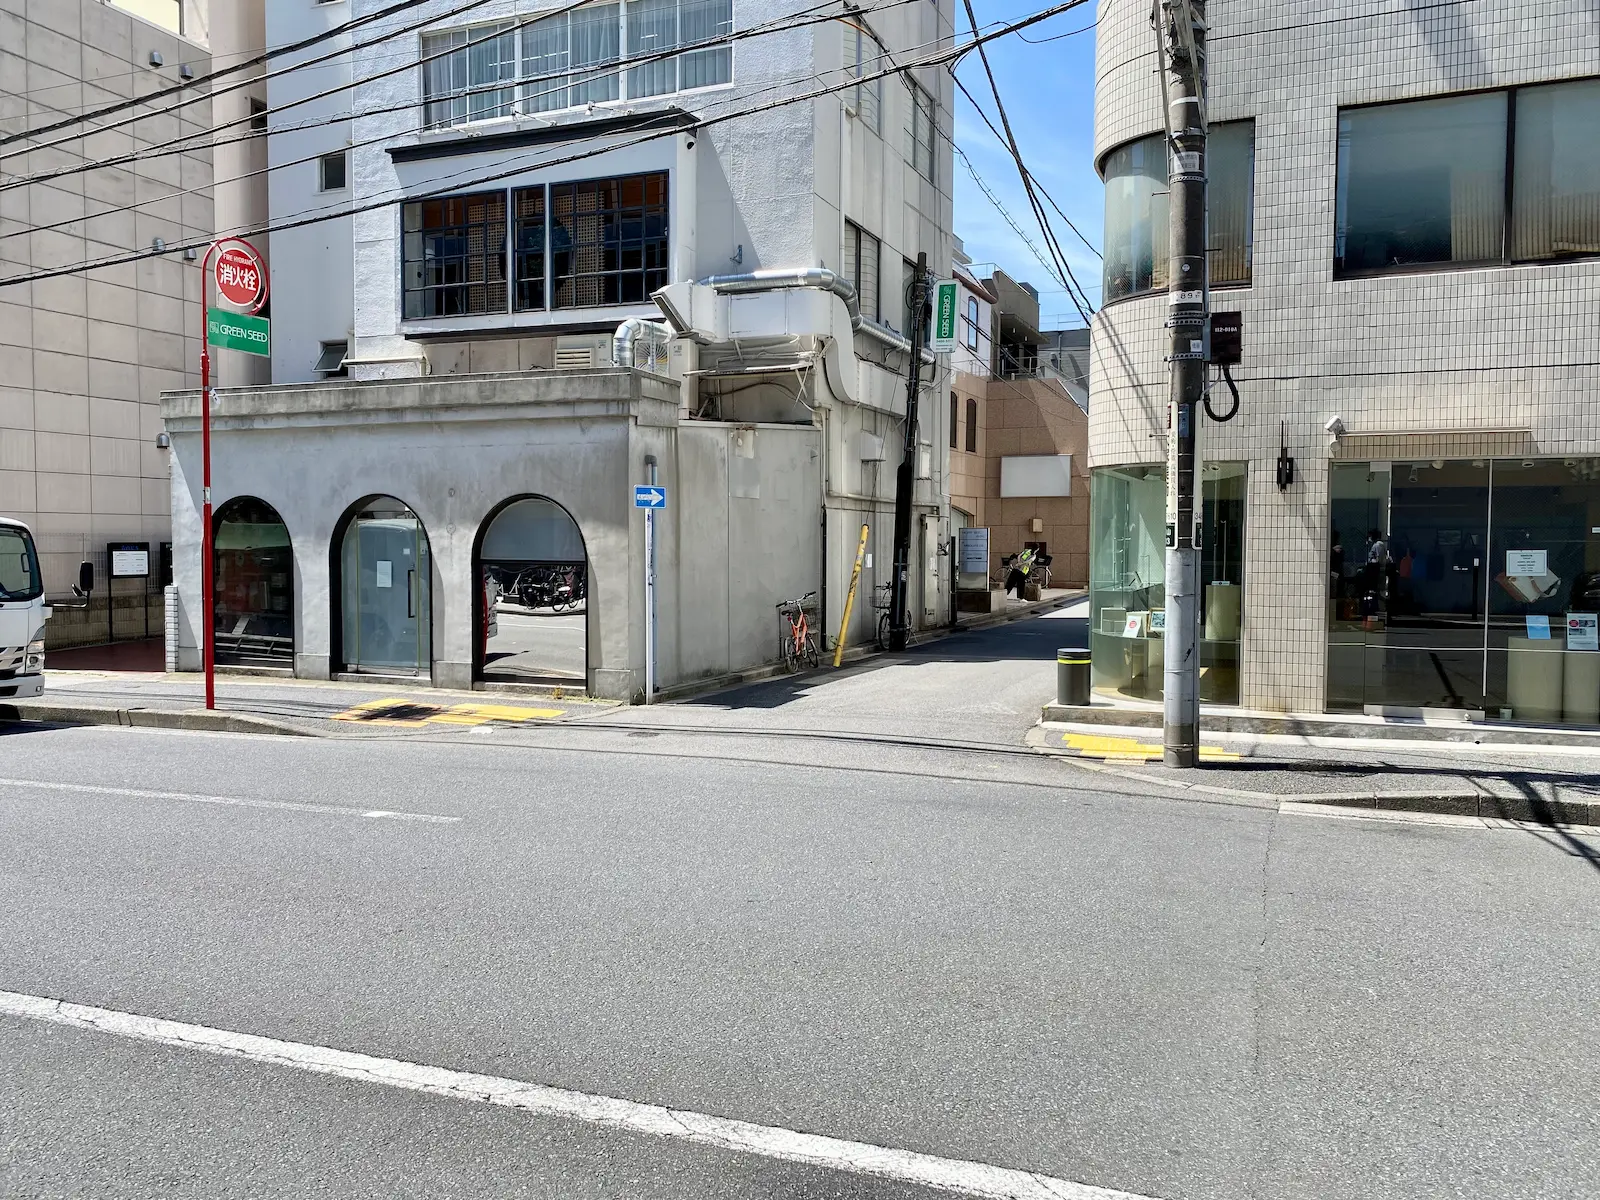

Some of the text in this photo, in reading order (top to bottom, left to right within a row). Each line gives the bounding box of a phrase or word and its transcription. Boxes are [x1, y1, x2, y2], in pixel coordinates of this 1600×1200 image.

[223, 253, 253, 265] FIRE HYDRANT
[219, 262, 257, 291] 消火栓
[220, 324, 268, 342] GREEN SEED
[942, 319, 950, 337] SEED
